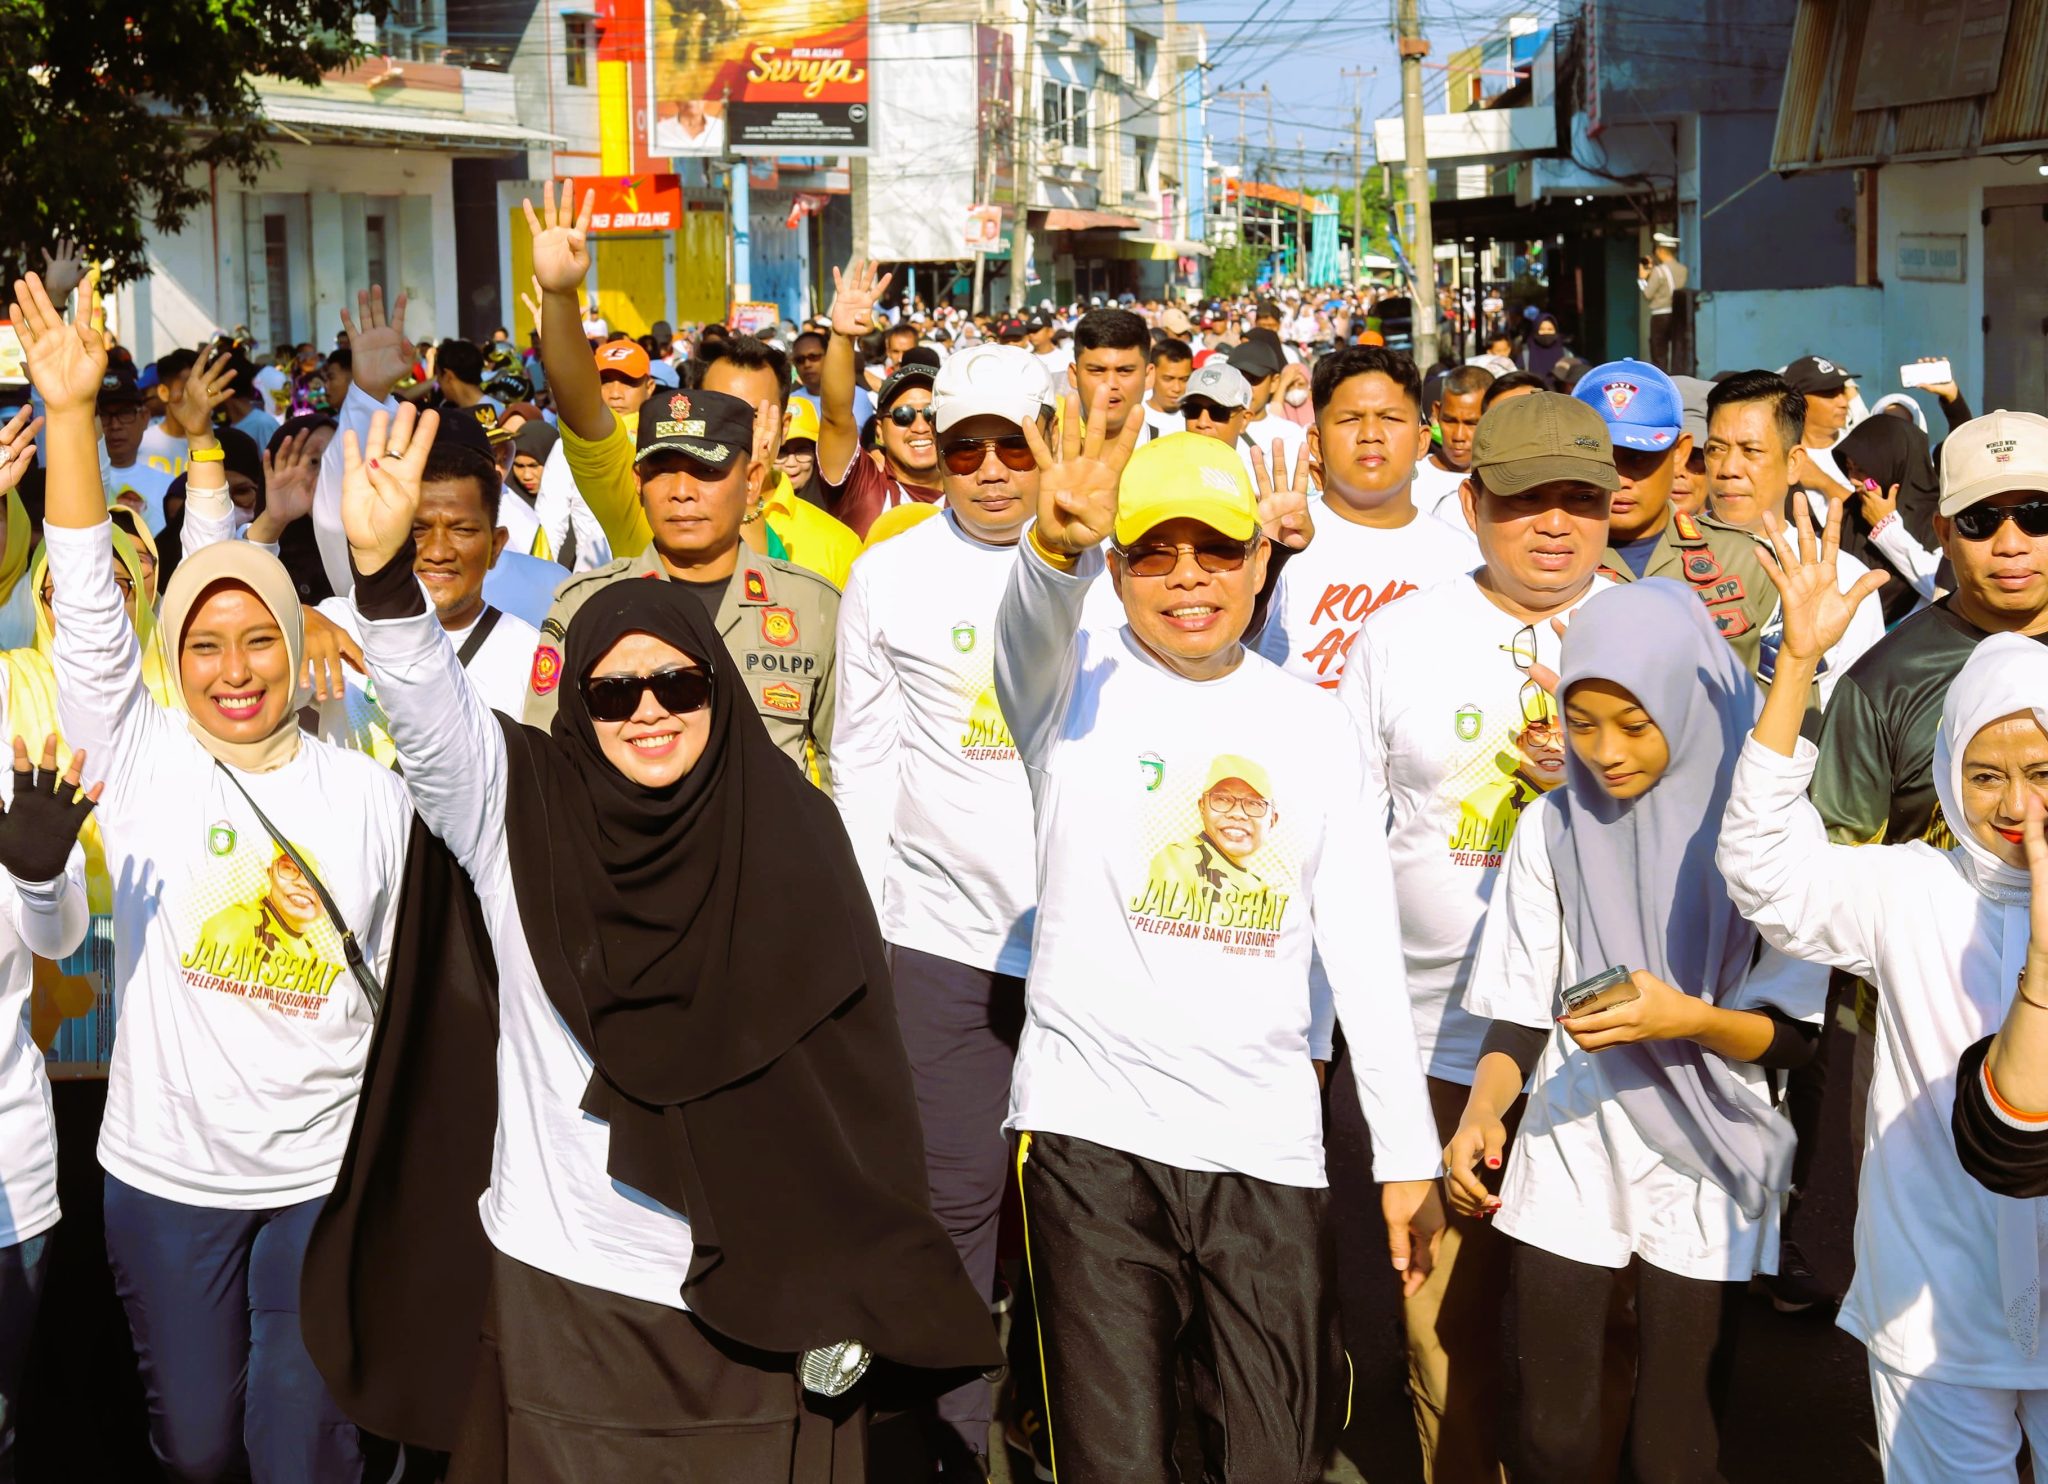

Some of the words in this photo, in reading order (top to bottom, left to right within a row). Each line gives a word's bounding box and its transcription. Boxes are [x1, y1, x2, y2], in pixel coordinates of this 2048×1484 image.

[746, 45, 865, 98] Surya
[1990, 446, 2014, 454] ENGLAND
[746, 653, 814, 675] POLPP
[1449, 852, 1502, 868] “PELEPASA
[1129, 878, 1216, 924] JALAN
[1217, 888, 1290, 932] SEHAT
[1202, 927, 1232, 944] SANG
[181, 937, 265, 982] JALAN
[263, 953, 346, 996] SEHAT
